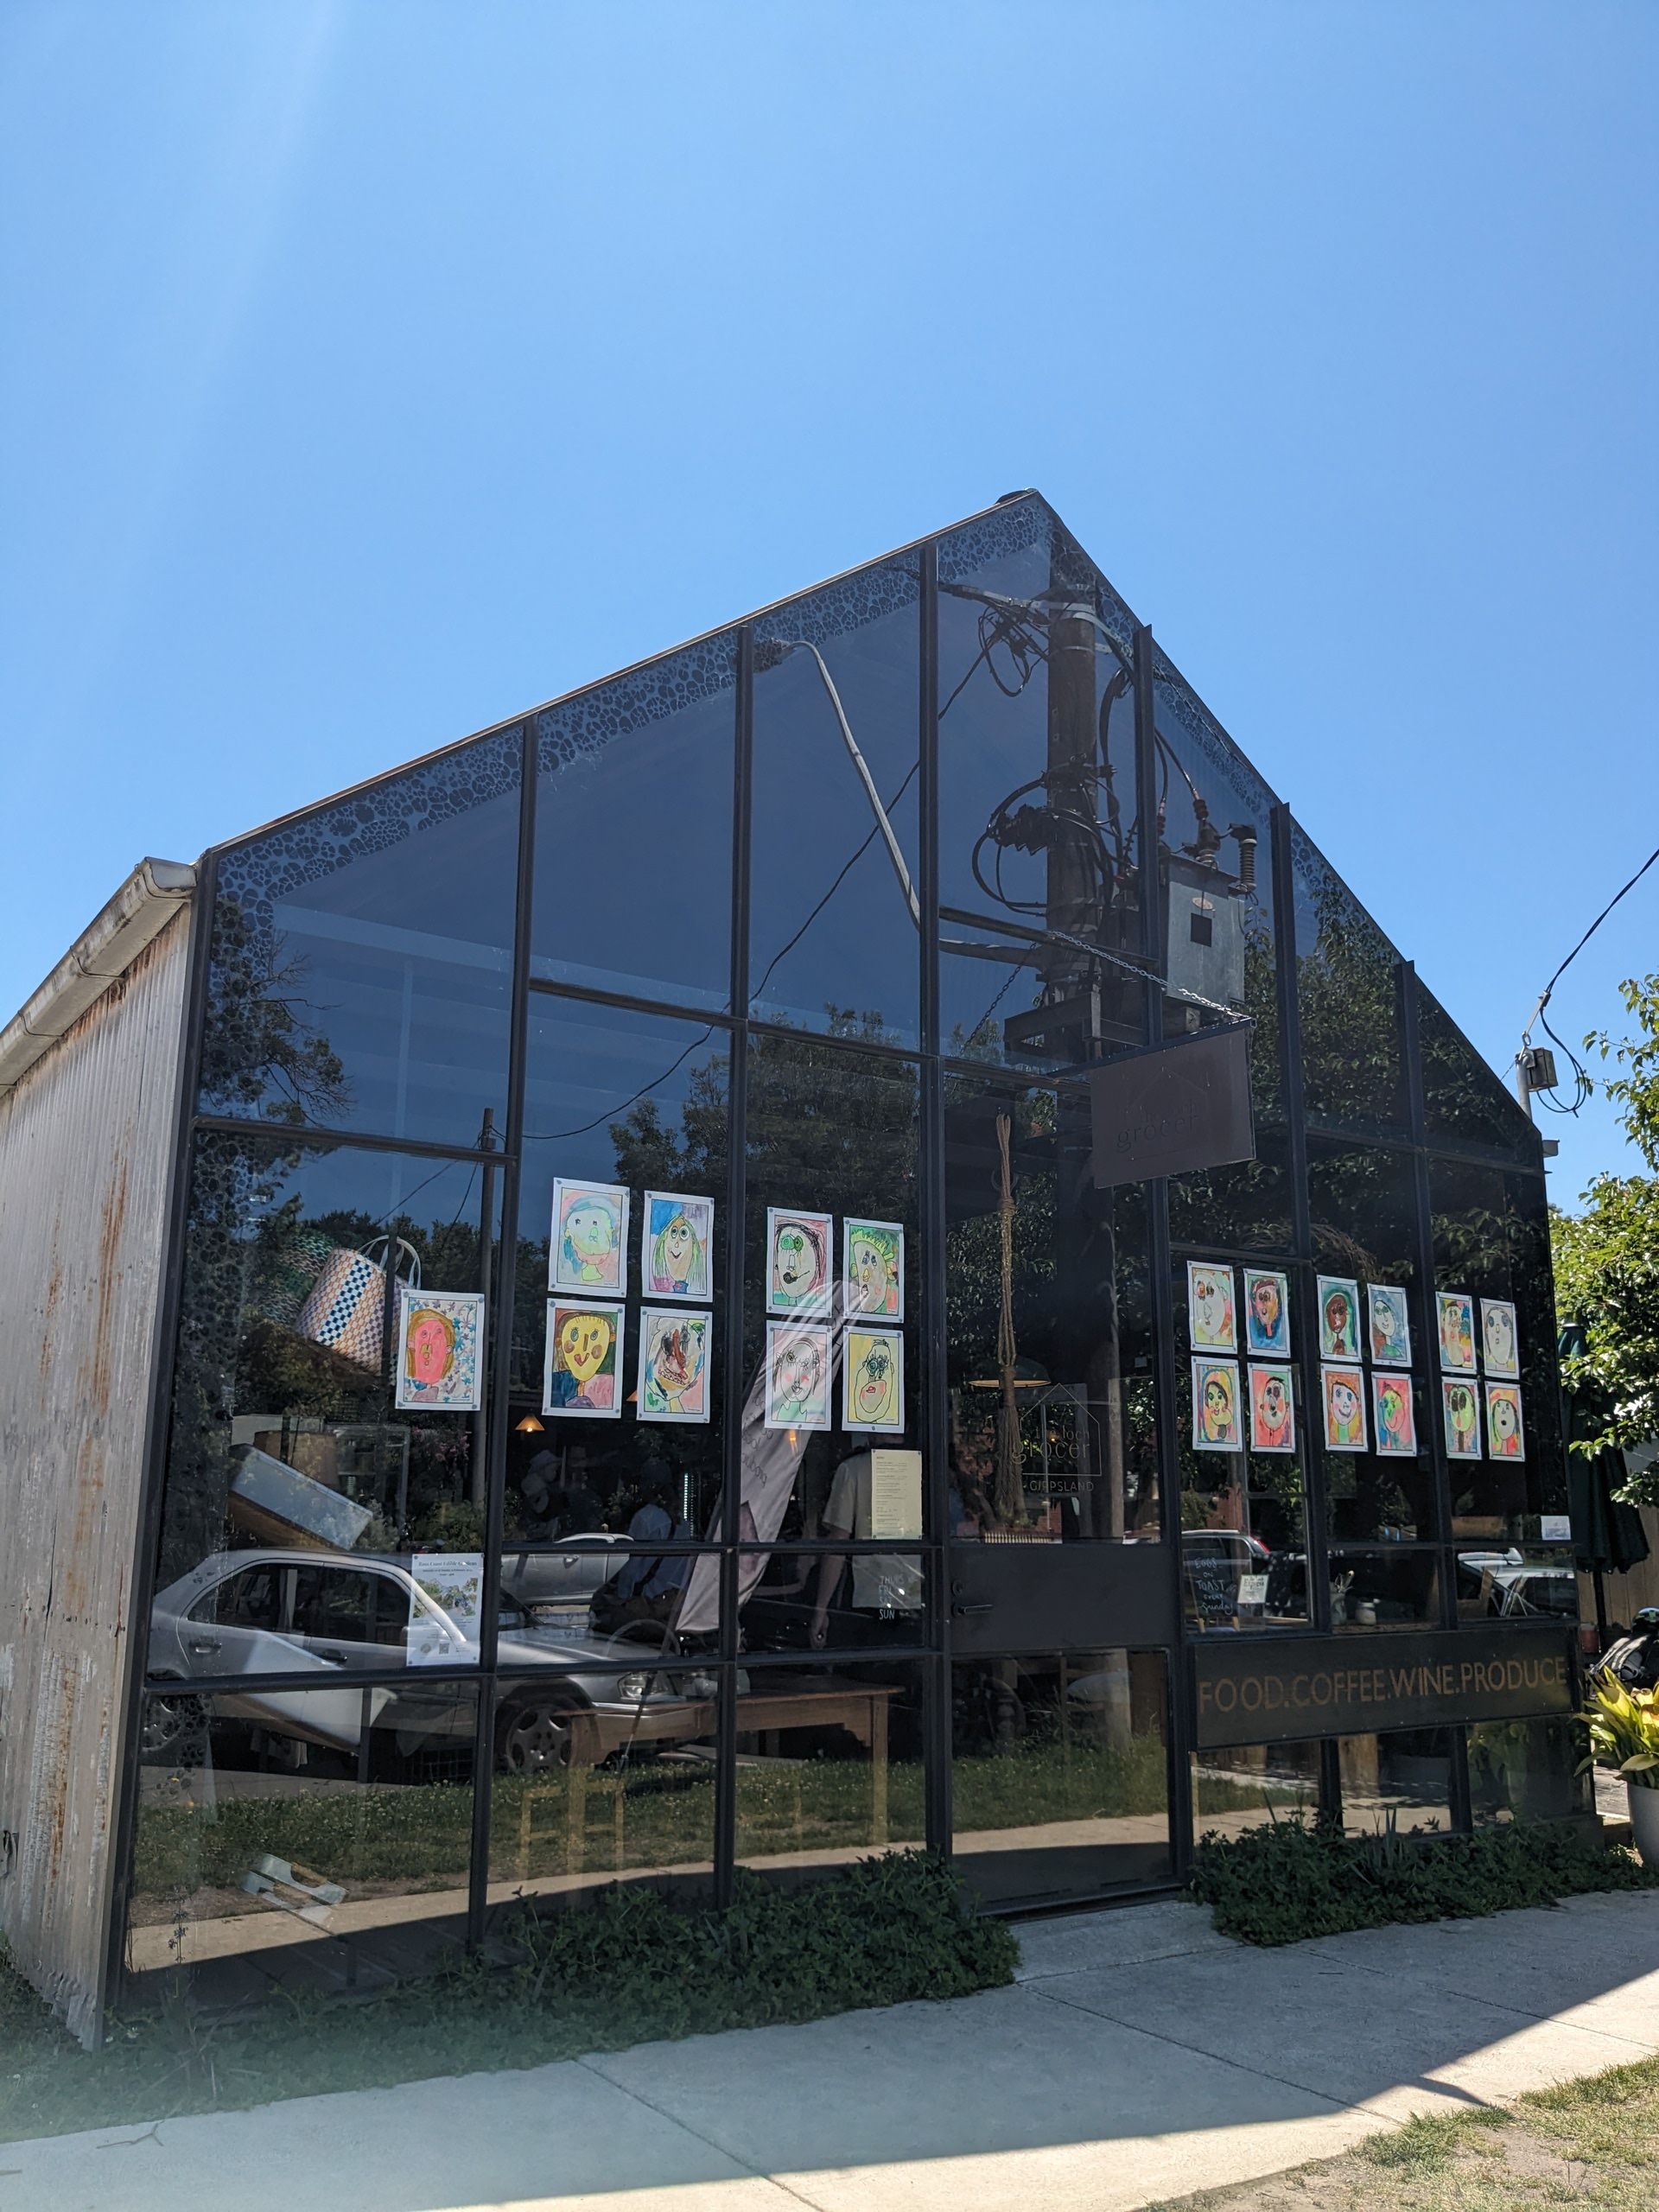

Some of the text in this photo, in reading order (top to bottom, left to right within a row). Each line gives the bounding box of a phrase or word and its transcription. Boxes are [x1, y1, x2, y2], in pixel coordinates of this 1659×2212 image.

[1116, 1115, 1199, 1154] grocer
[1011, 1440, 1090, 1465] grocer
[1029, 1480, 1095, 1493] GIPPSLAND
[1195, 1579, 1225, 1591] TOAST
[879, 1608, 895, 1620] SUN
